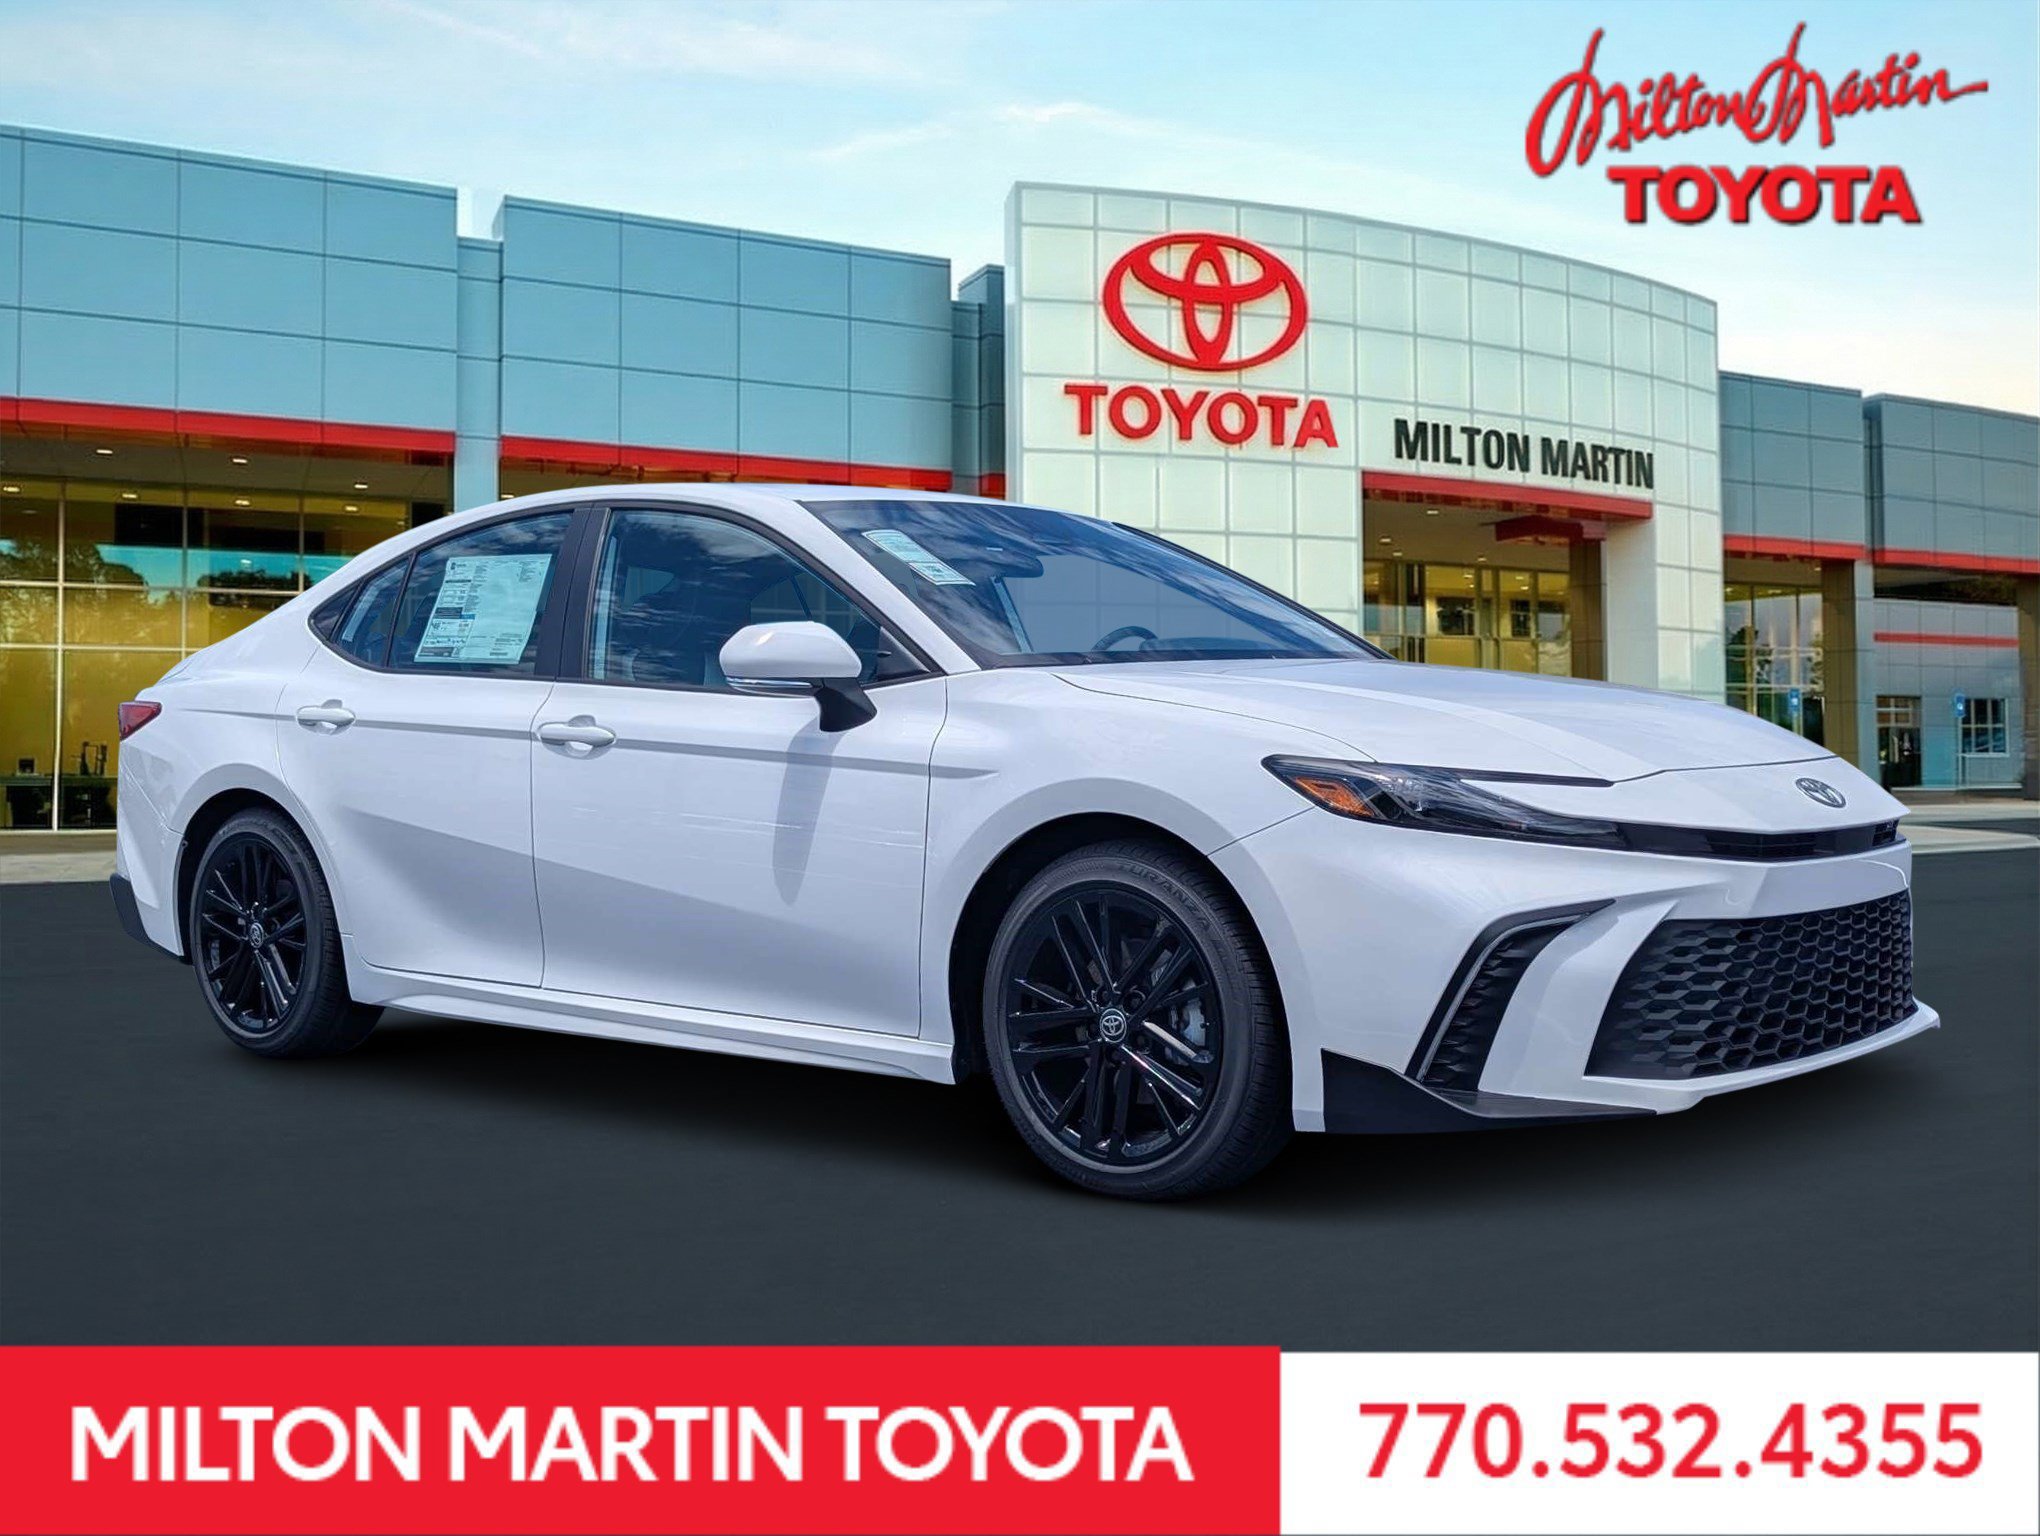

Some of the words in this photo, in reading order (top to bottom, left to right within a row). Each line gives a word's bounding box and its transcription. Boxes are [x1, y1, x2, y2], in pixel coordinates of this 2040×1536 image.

[1064, 382, 1339, 449] TOYOTA
[1394, 418, 1531, 474] MILTON
[1540, 436, 1655, 490] MARTIN
